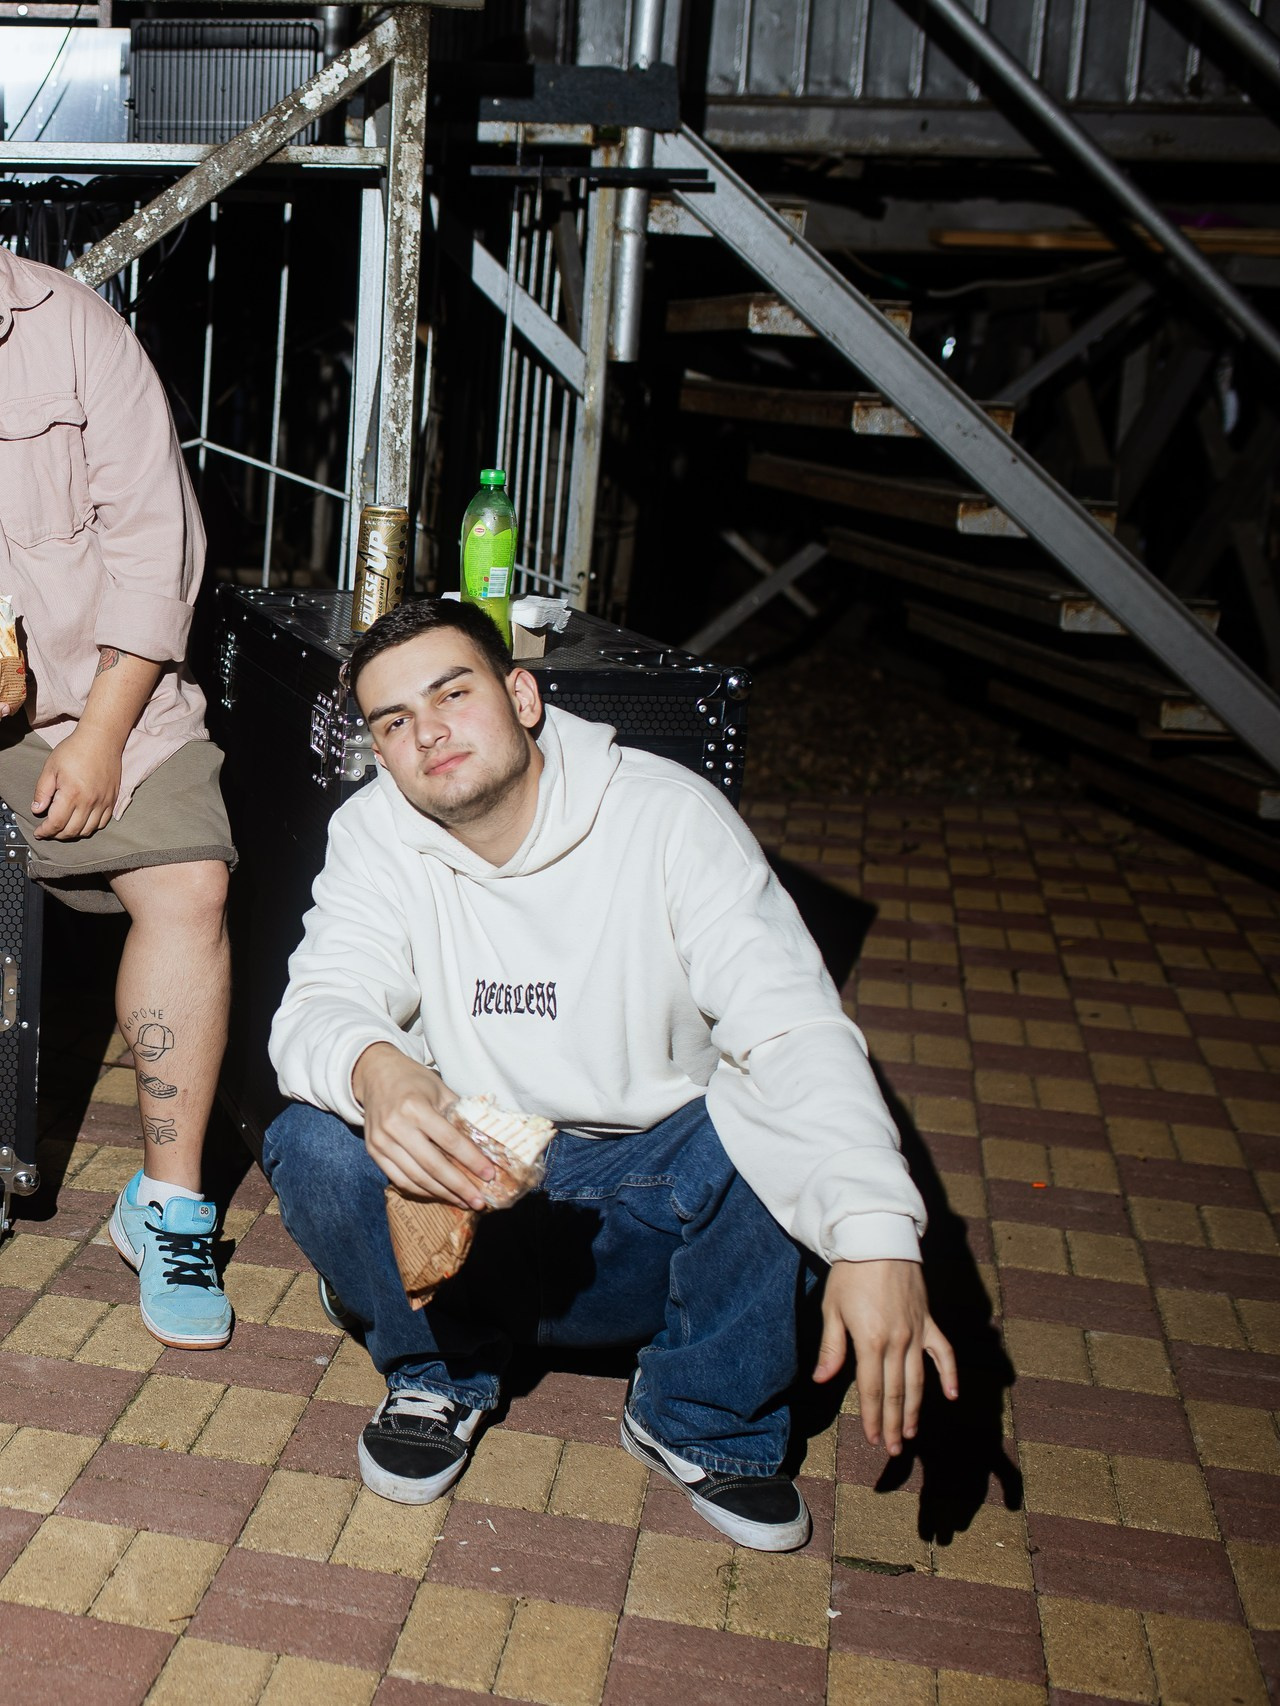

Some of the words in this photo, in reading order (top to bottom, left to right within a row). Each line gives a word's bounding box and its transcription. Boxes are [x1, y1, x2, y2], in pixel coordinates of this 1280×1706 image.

[367, 530, 389, 571] UP
[362, 570, 379, 626] PULSE
[471, 978, 557, 1021] RECKLESS
[123, 1008, 164, 1032] КОРОЧЕ
[200, 1207, 209, 1215] 58
[392, 1198, 418, 1237] Market
